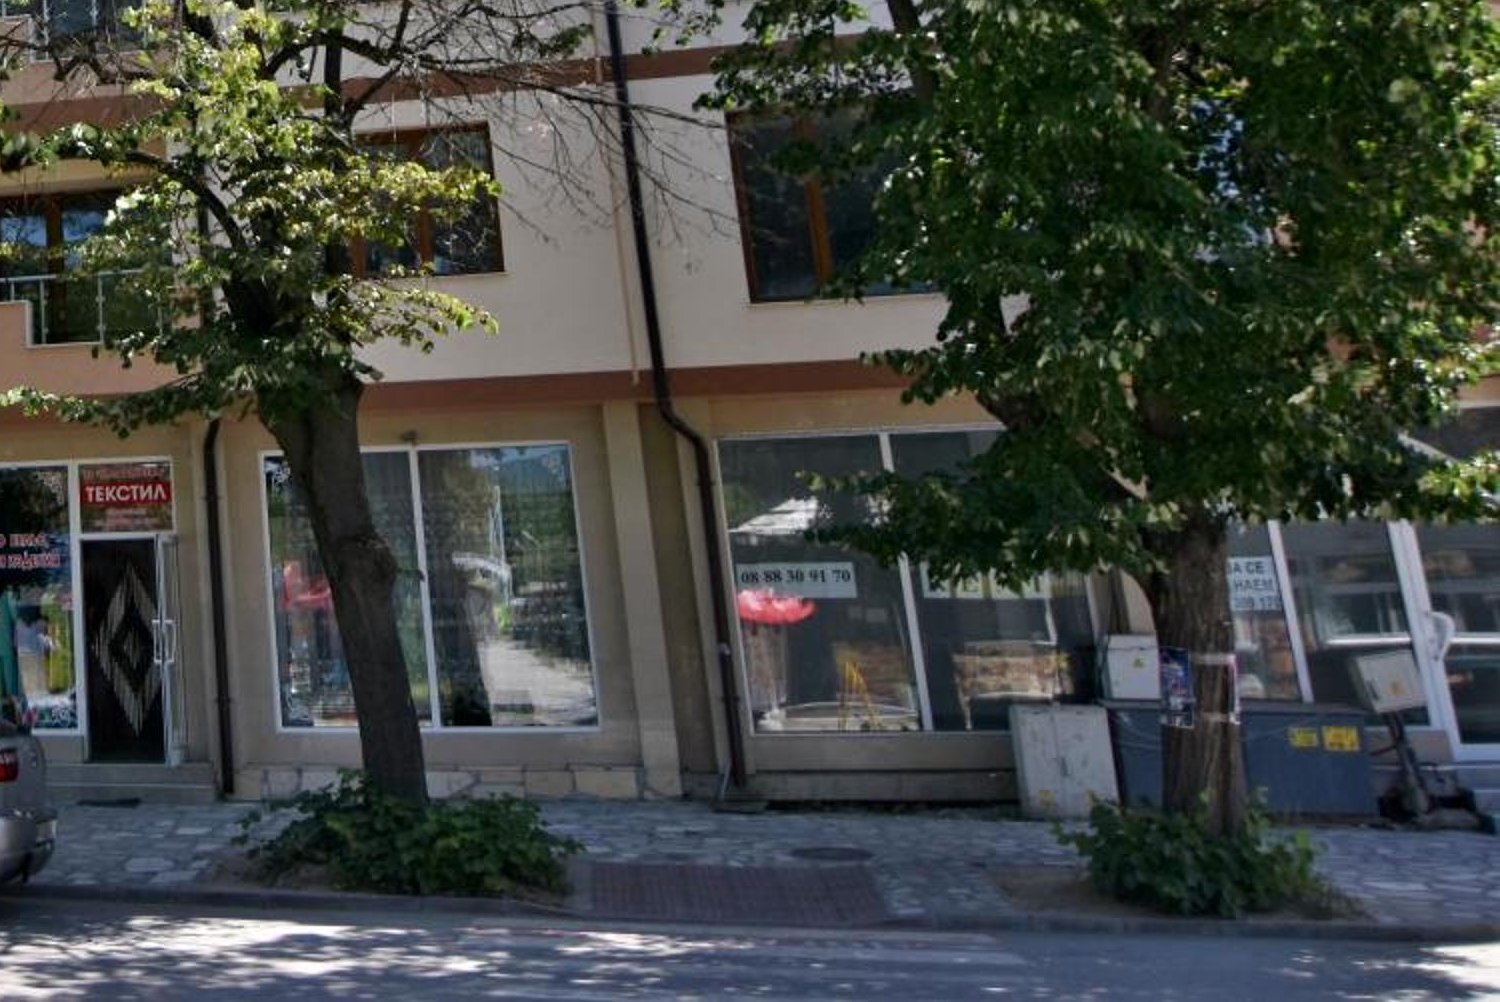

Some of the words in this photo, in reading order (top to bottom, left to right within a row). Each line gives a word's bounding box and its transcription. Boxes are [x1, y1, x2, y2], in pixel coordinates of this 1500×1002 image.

[84, 484, 168, 502] ТЕКСТИЛ
[741, 570, 759, 584] 08
[831, 568, 851, 583] 70
